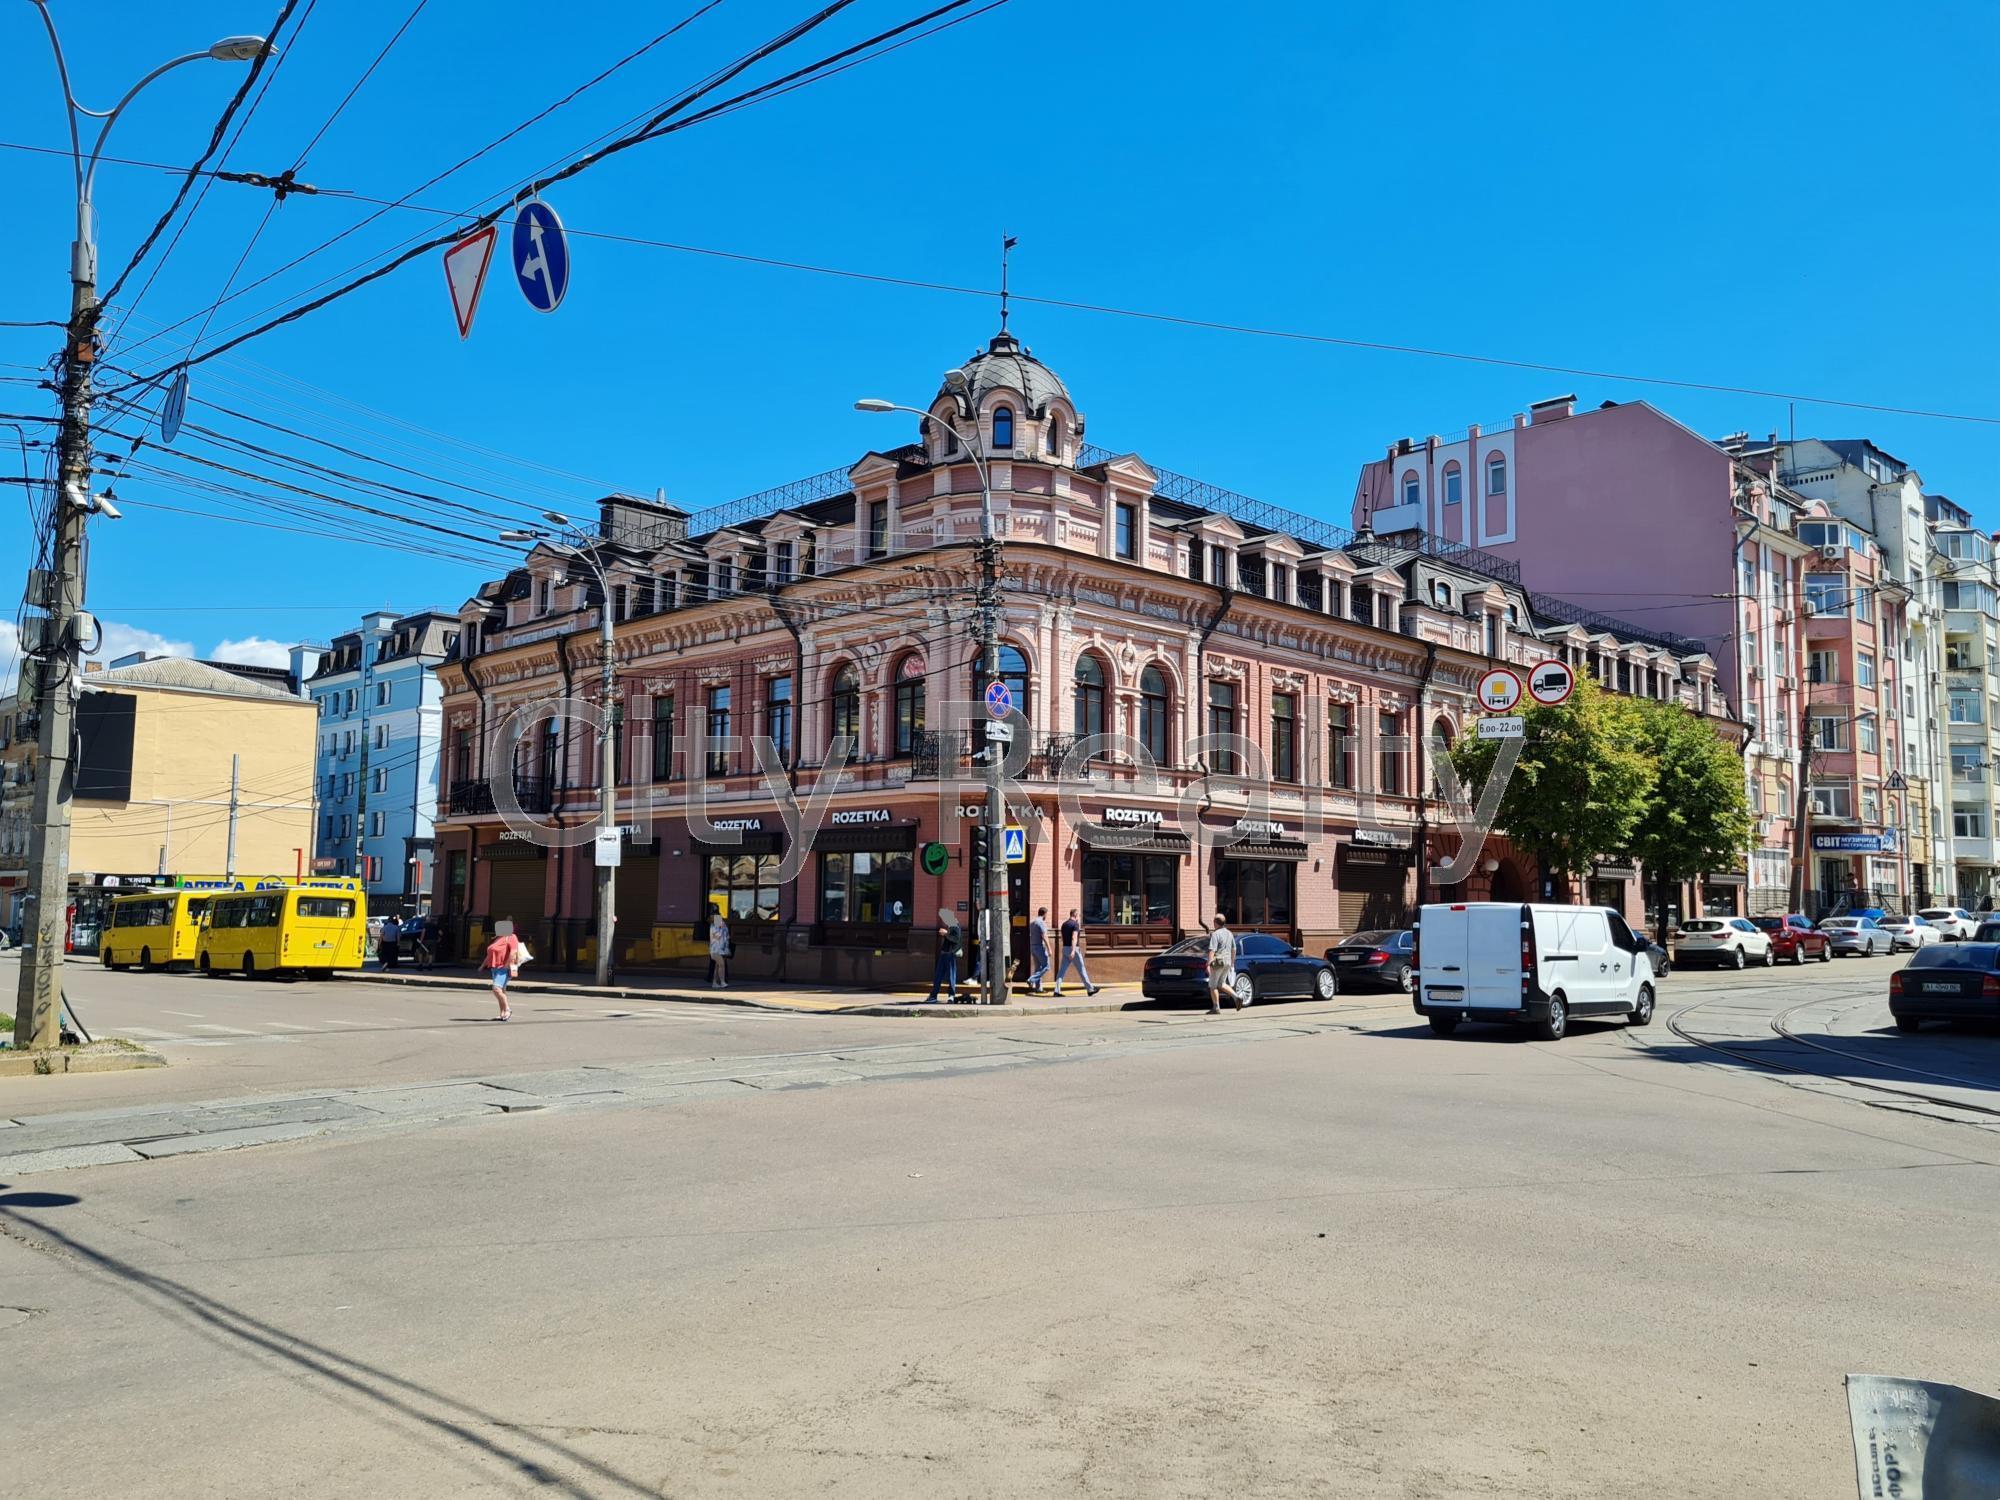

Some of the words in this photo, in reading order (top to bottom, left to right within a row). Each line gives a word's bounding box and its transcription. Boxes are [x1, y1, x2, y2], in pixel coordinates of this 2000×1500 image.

[1480, 722, 1521, 733] 6.00-22.00
[832, 809, 890, 824] ROZETKA
[954, 805, 1046, 818] ROTKA
[1105, 808, 1163, 824] ROZETKA
[620, 825, 641, 835] ETKA
[714, 819, 761, 831] ROZETKA
[1236, 820, 1285, 834] ROZETKA
[499, 831, 532, 840] ROZETKA
[1355, 829, 1395, 843] ROZETKA
[1816, 836, 1840, 848] СВІТ
